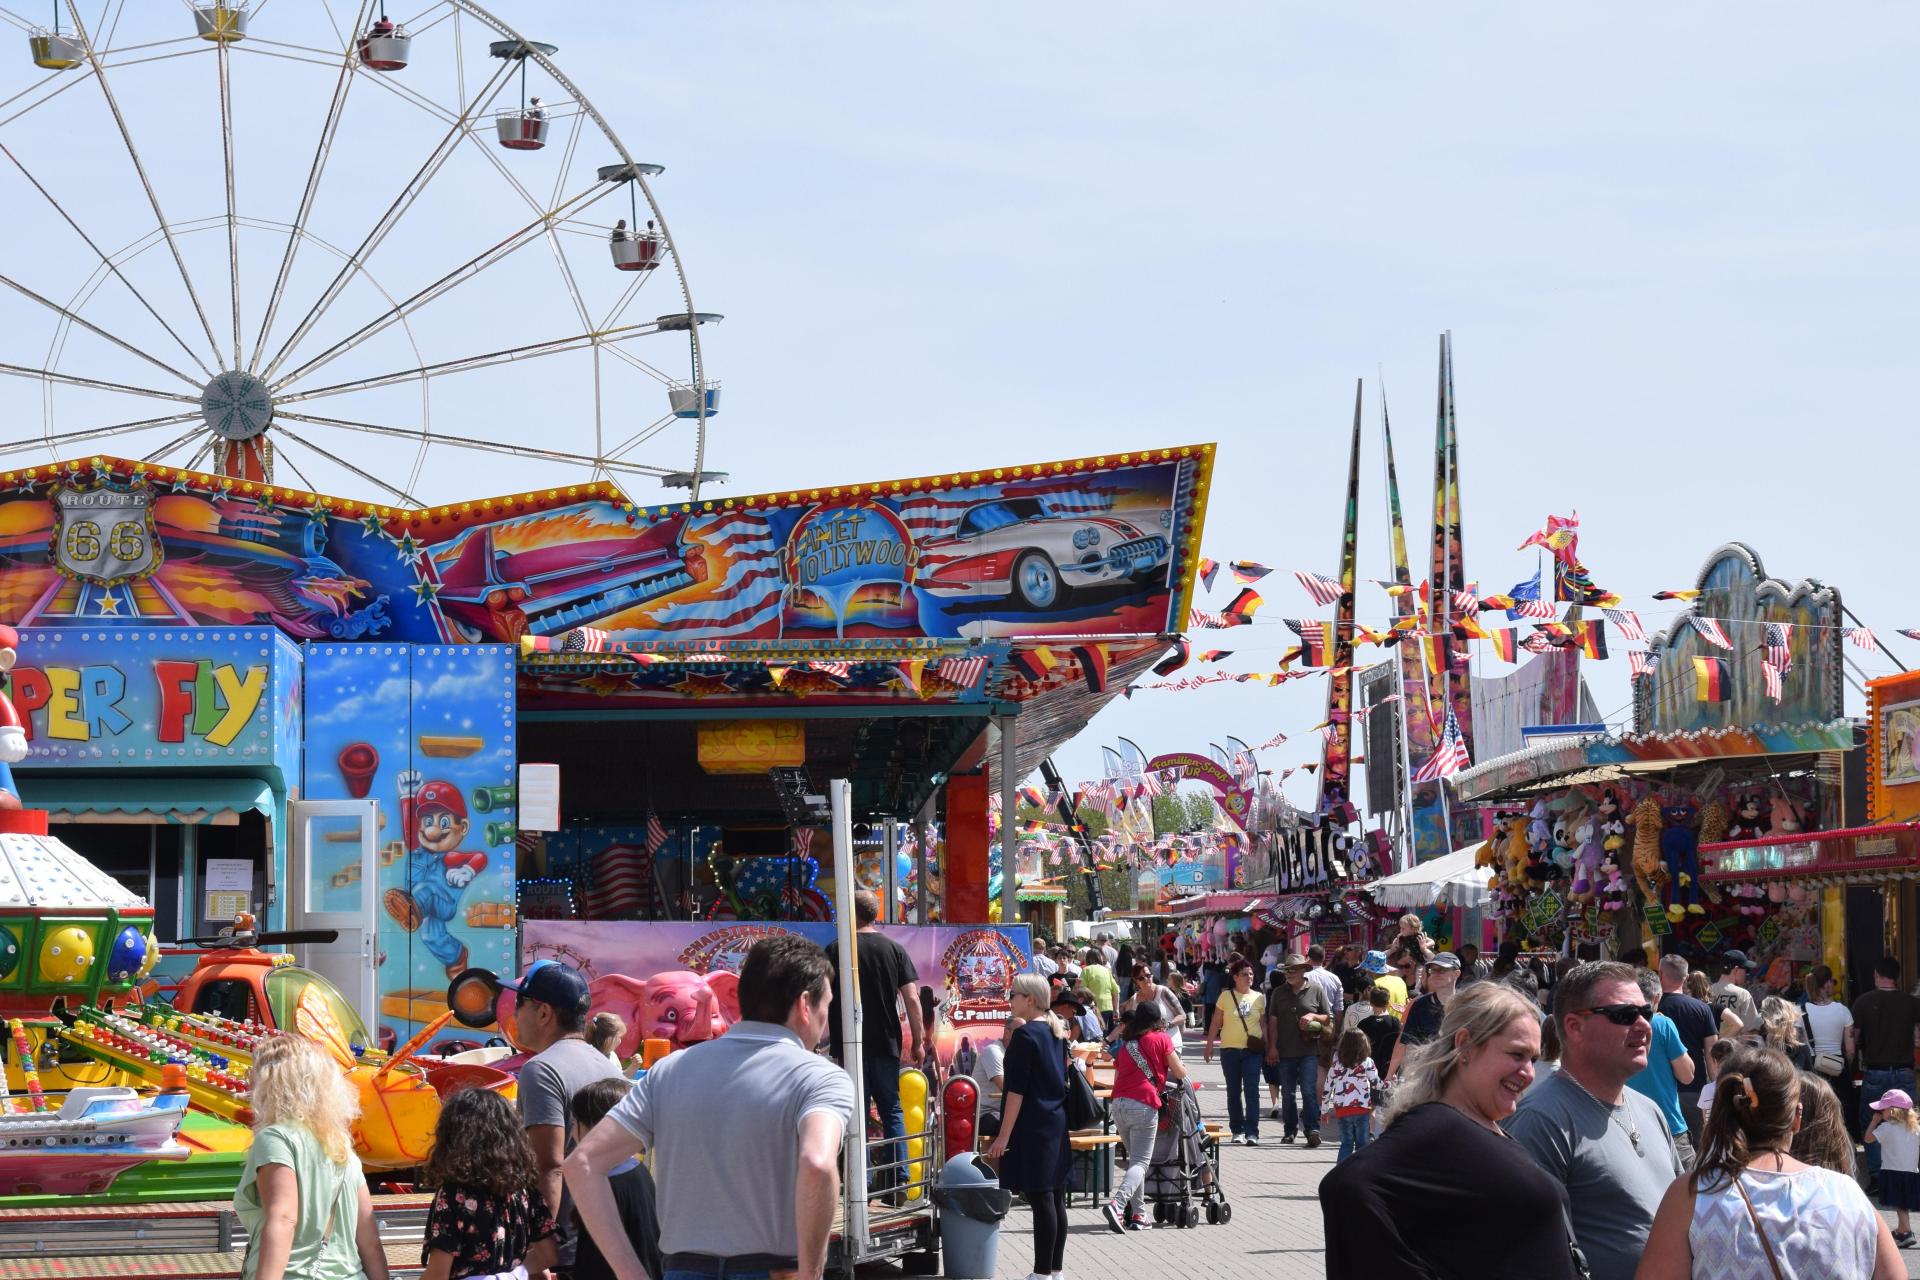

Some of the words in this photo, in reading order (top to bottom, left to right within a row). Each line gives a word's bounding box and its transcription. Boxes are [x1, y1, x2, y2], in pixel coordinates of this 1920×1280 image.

[66, 495, 145, 506] ROUTE
[67, 521, 144, 561] 66
[783, 540, 921, 609] HOLLYWOOD
[3, 663, 134, 743] PER
[153, 659, 269, 748] FLY
[953, 1009, 1012, 1021] C.Paulus
